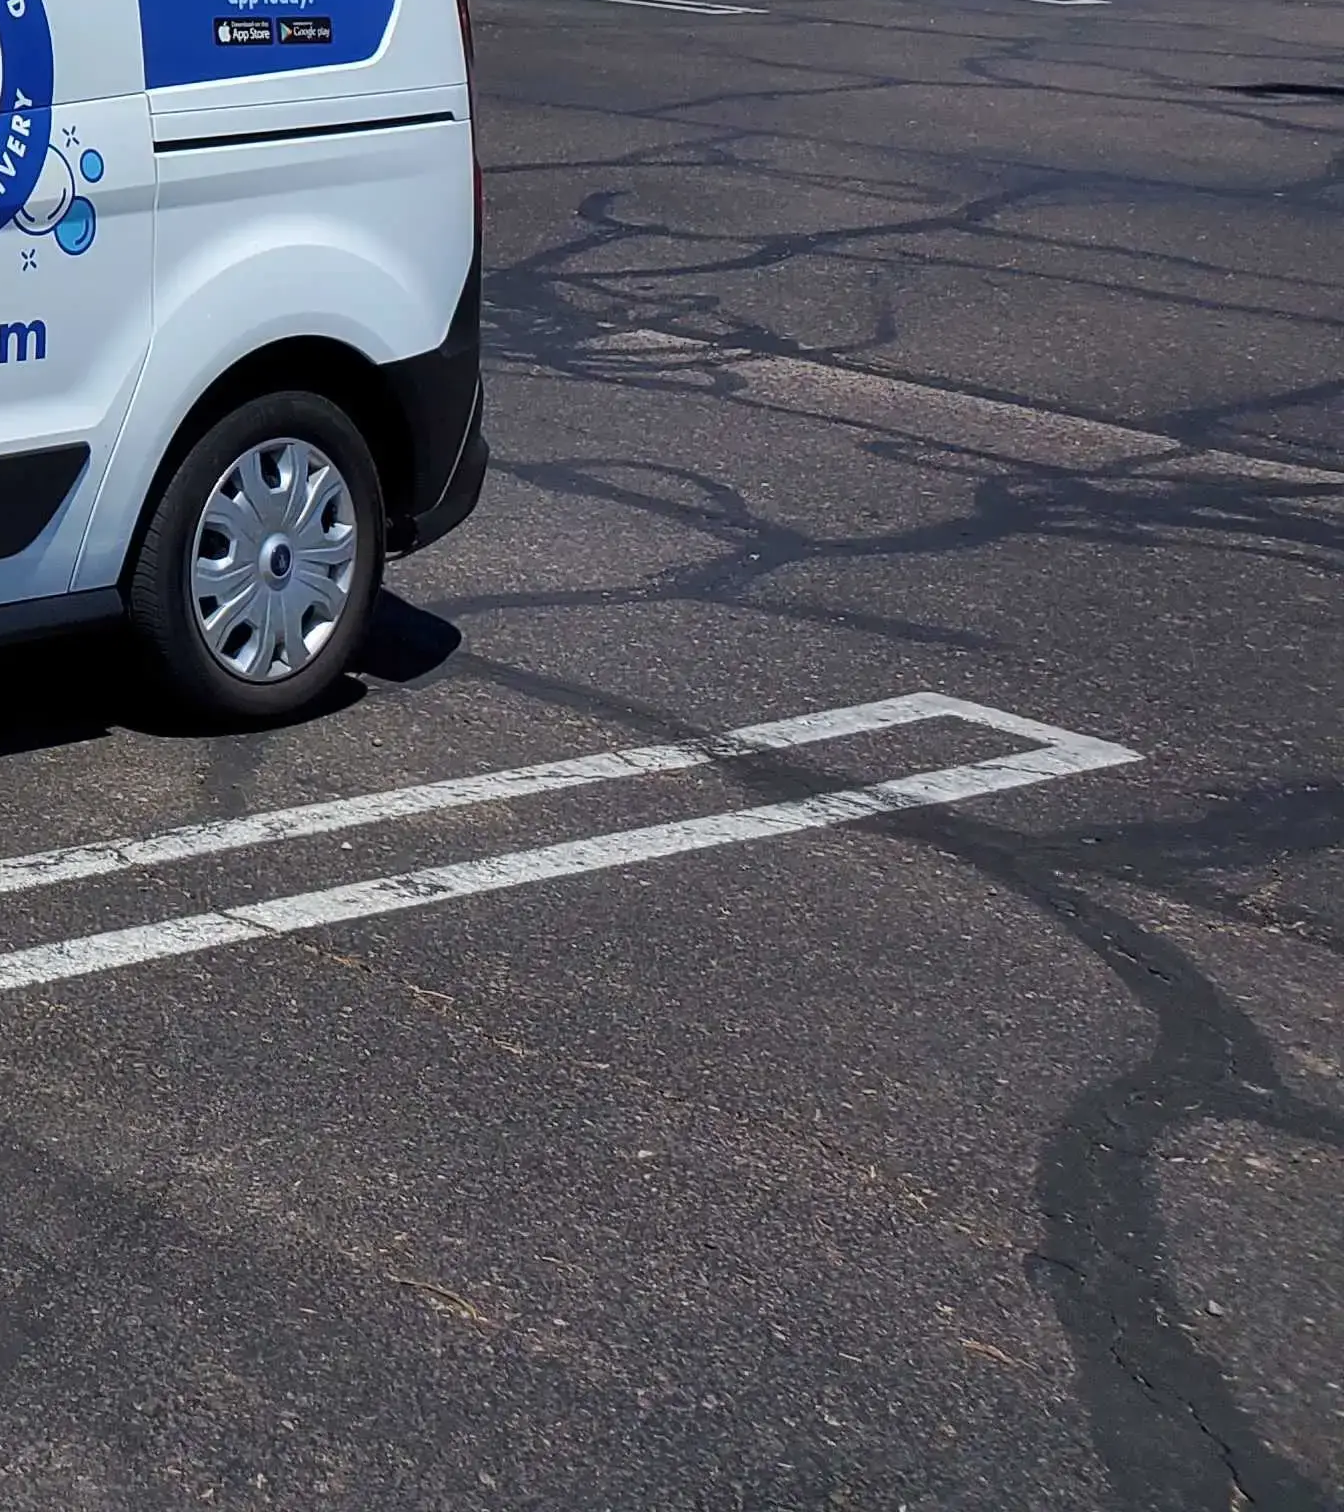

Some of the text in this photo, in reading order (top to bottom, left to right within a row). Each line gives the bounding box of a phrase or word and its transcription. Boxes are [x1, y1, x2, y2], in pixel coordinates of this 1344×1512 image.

[232, 27, 270, 42] App Store
[293, 26, 316, 39] Google
